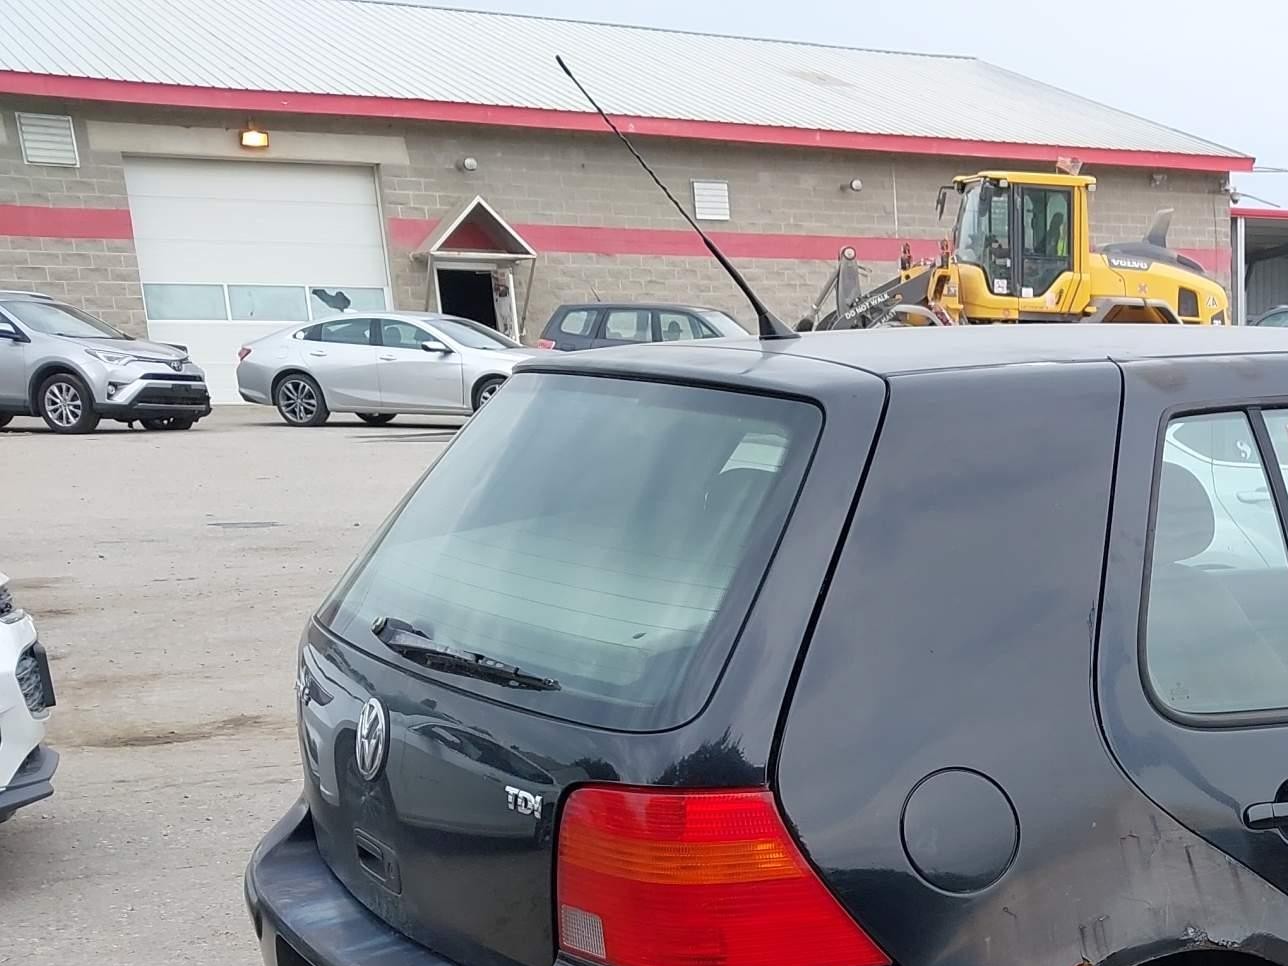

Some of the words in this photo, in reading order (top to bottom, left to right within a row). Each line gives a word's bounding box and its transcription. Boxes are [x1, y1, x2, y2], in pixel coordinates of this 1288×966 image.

[1110, 258, 1149, 269] VOLVO
[845, 310, 856, 320] DO
[856, 302, 870, 314] NOT
[870, 291, 890, 306] WALK
[505, 785, 543, 819] TDI
